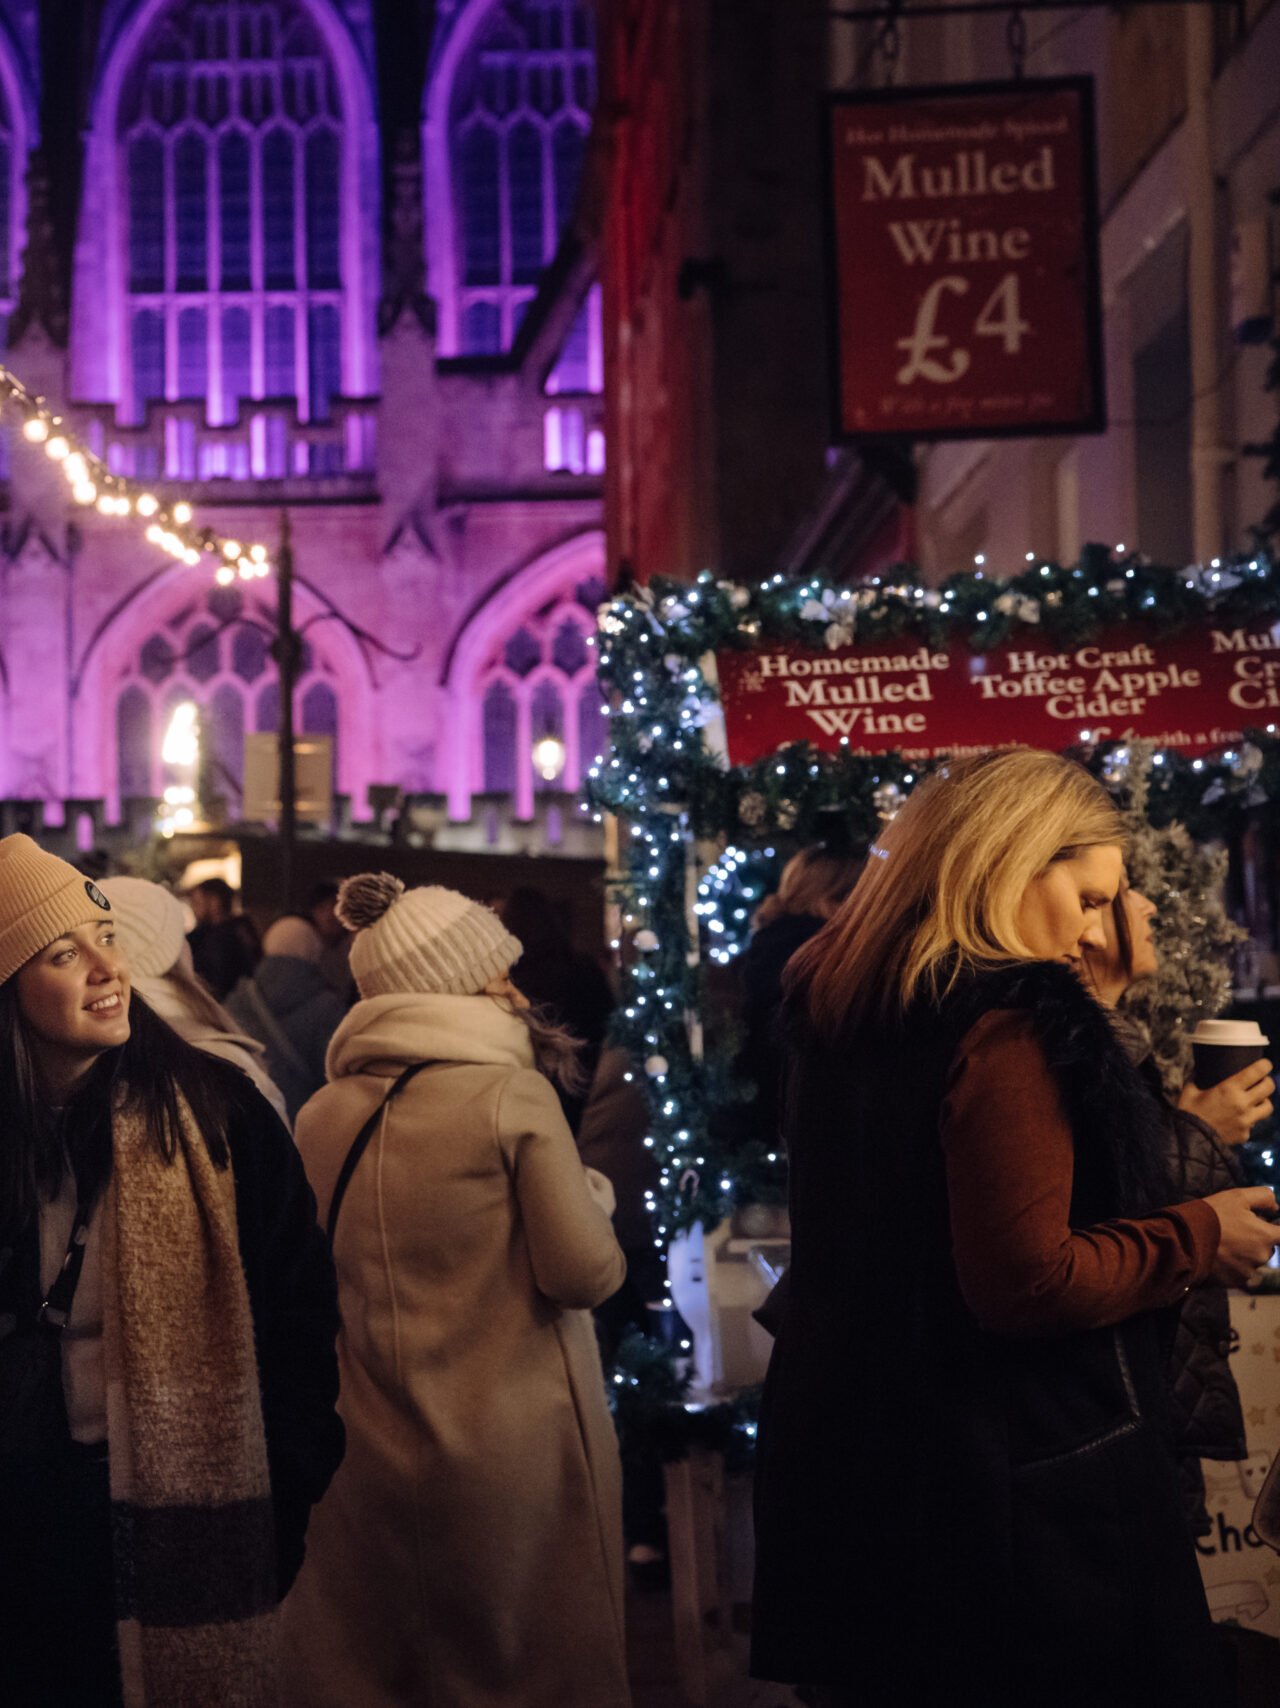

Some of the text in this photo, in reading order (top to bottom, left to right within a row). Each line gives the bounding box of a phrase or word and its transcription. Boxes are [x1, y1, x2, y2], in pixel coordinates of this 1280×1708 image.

[862, 146, 1055, 201] Mulled
[889, 219, 1032, 266] Wine
[896, 273, 1032, 385] £4
[759, 648, 950, 677] Homemade
[1008, 644, 1156, 673] Hot Craft
[784, 673, 934, 707] Mulled
[970, 664, 1201, 699] Toffee Apple
[807, 707, 927, 736] Wine
[1045, 694, 1146, 720] Cider
